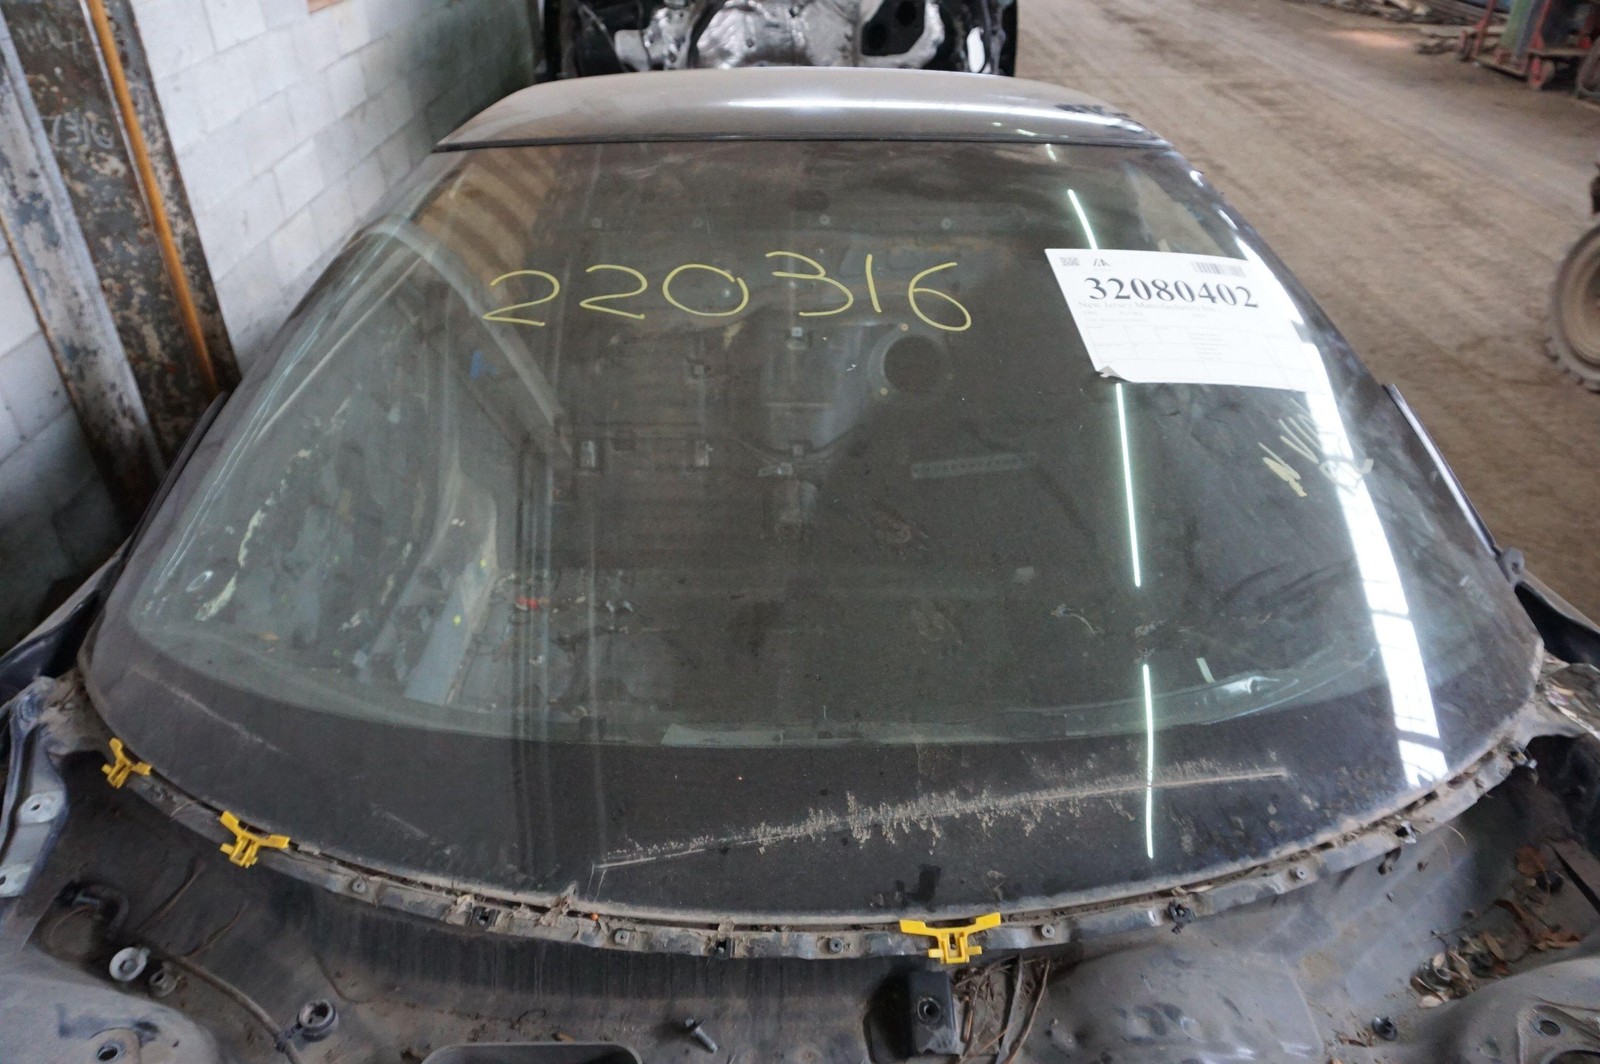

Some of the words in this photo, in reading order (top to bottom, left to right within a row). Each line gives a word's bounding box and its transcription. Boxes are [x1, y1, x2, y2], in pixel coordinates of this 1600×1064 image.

[482, 250, 972, 331] 220316
[1078, 301, 1102, 309] New
[1104, 302, 1132, 311] Jersey
[1084, 276, 1259, 309] 32080402
